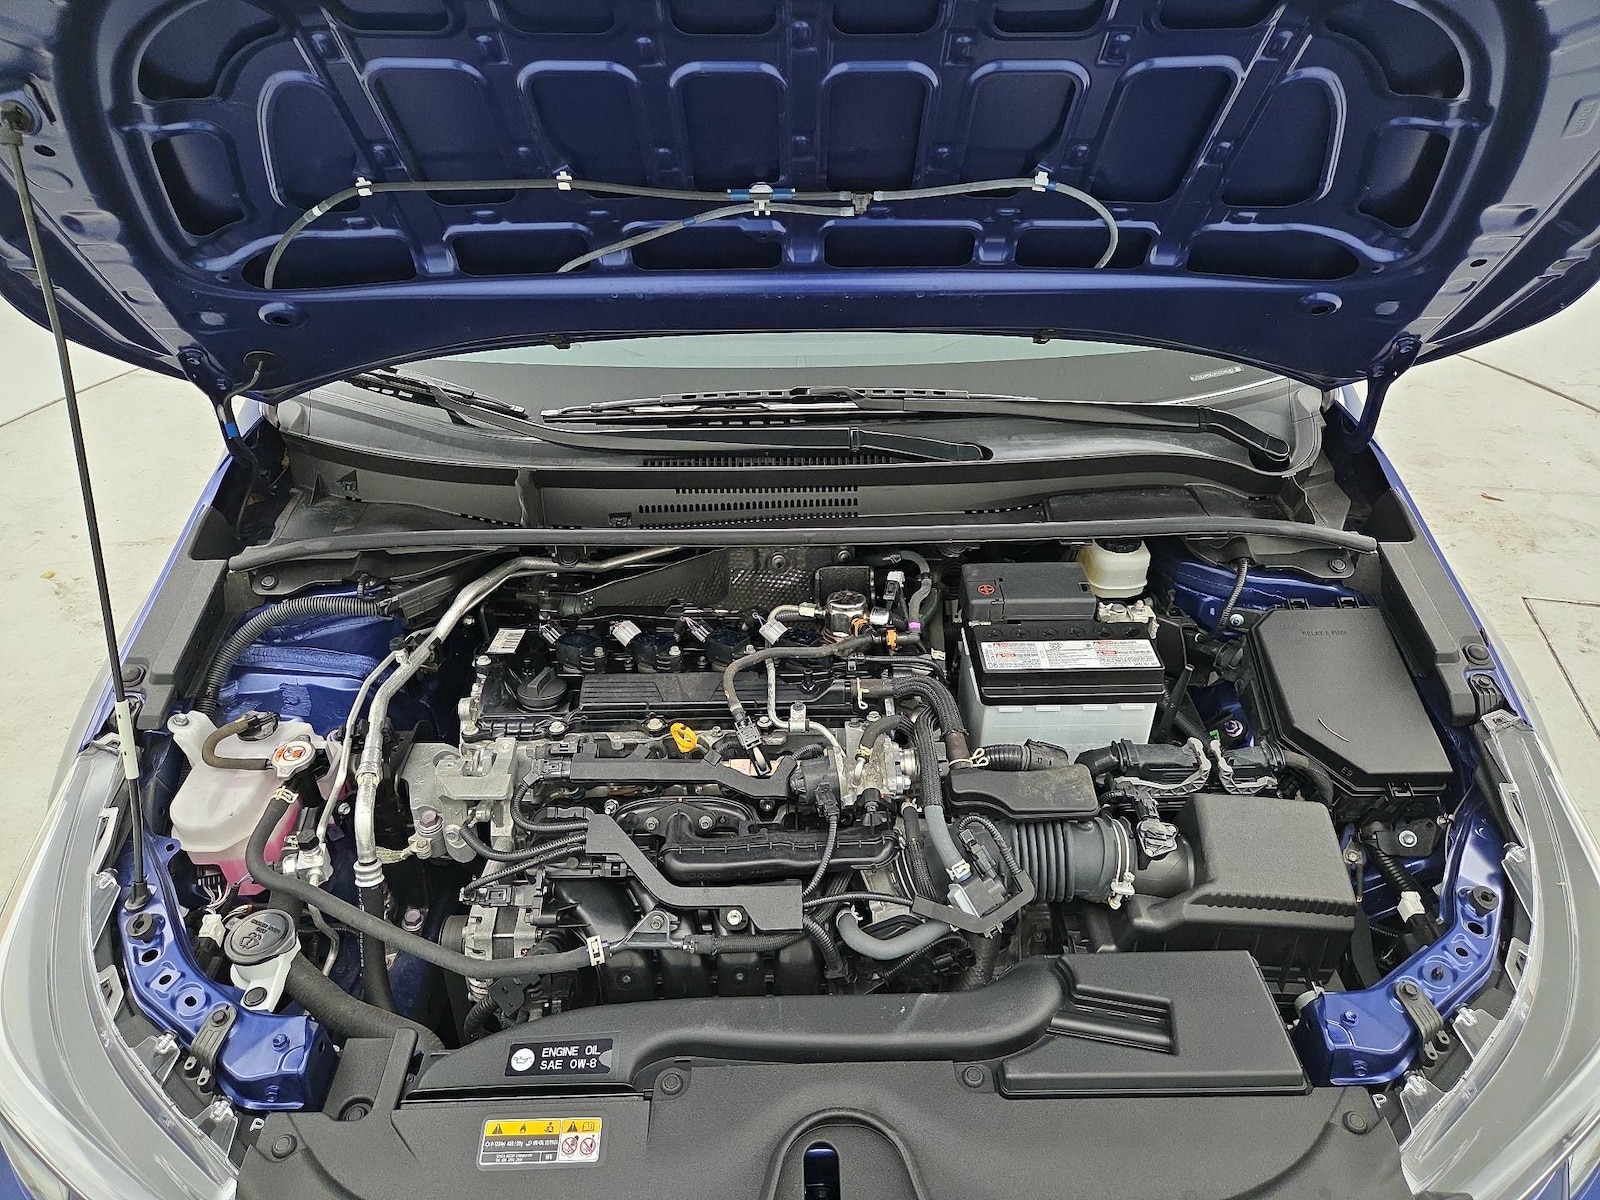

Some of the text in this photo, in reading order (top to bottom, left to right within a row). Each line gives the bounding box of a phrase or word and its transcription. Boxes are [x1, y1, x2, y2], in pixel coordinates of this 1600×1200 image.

[541, 1045, 601, 1058] ENGINE OIL
[539, 1060, 564, 1070] SAE
